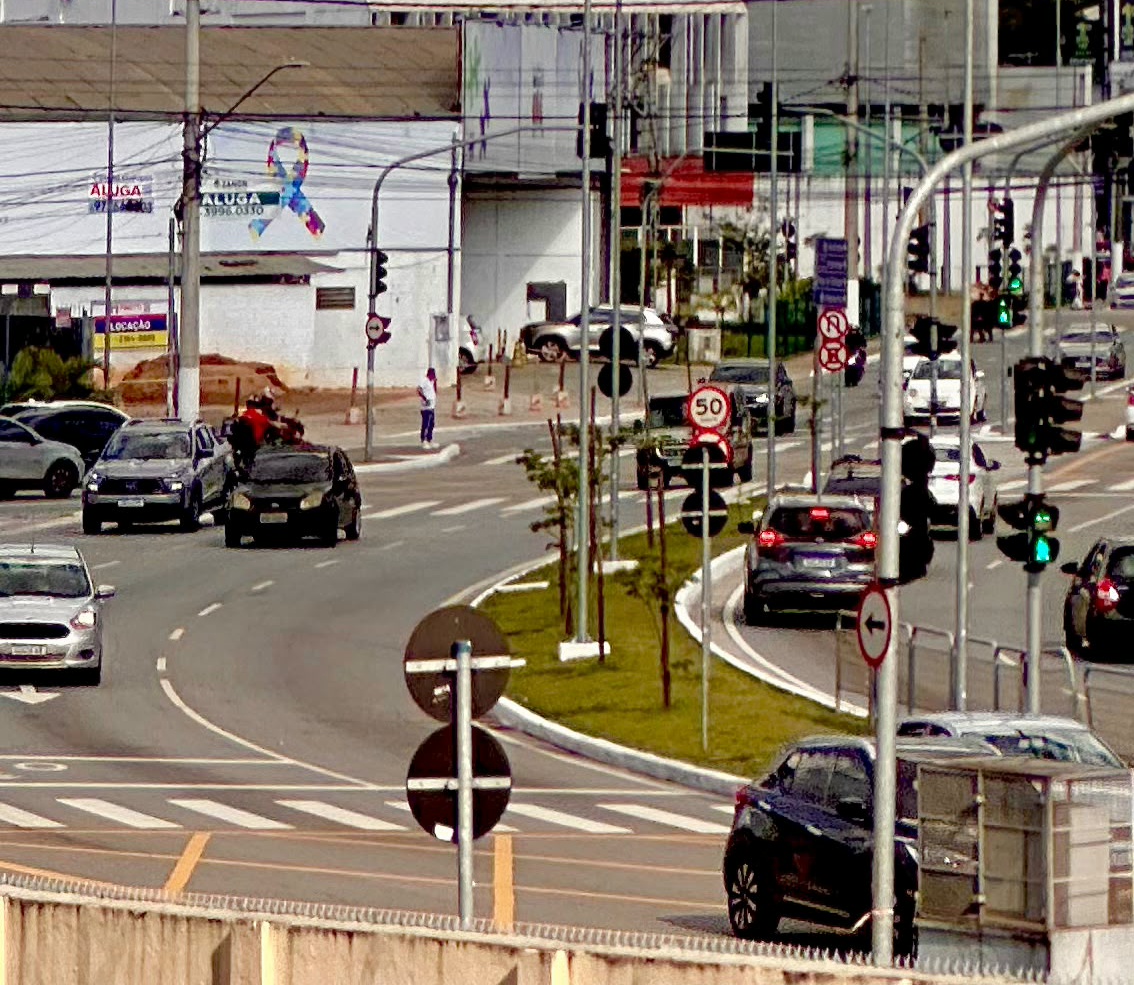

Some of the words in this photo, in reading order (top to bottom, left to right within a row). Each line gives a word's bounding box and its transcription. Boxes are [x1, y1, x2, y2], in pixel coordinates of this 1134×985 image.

[90, 183, 142, 196] ALUGA
[201, 193, 261, 206] ALUGA
[110, 319, 151, 332] LOCAÇÃO
[696, 398, 723, 416] 50
